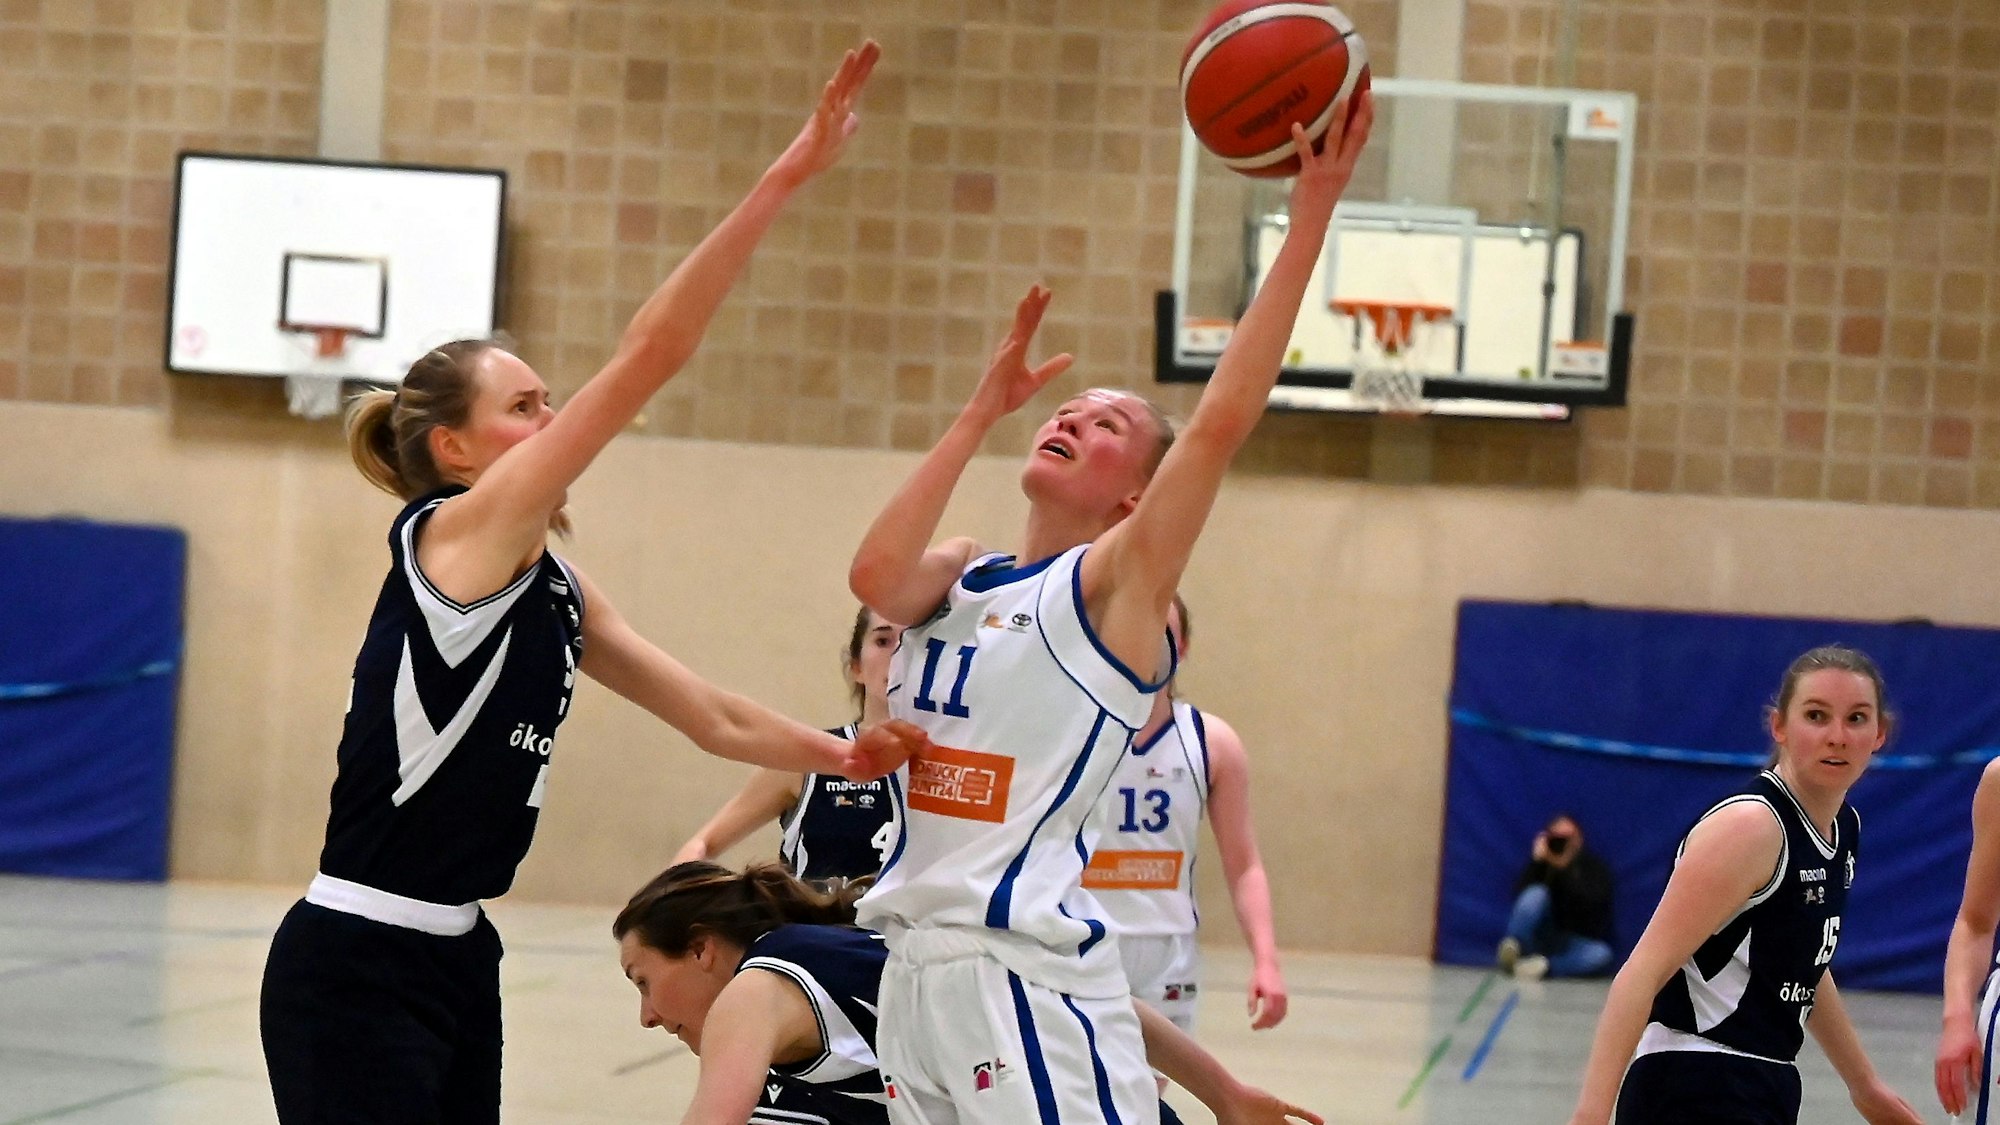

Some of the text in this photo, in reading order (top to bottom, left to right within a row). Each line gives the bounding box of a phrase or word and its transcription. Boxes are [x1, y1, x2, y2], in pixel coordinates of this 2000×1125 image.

[913, 637, 978, 719] 11
[1118, 787, 1171, 833] 13
[1814, 916, 1841, 966] 15
